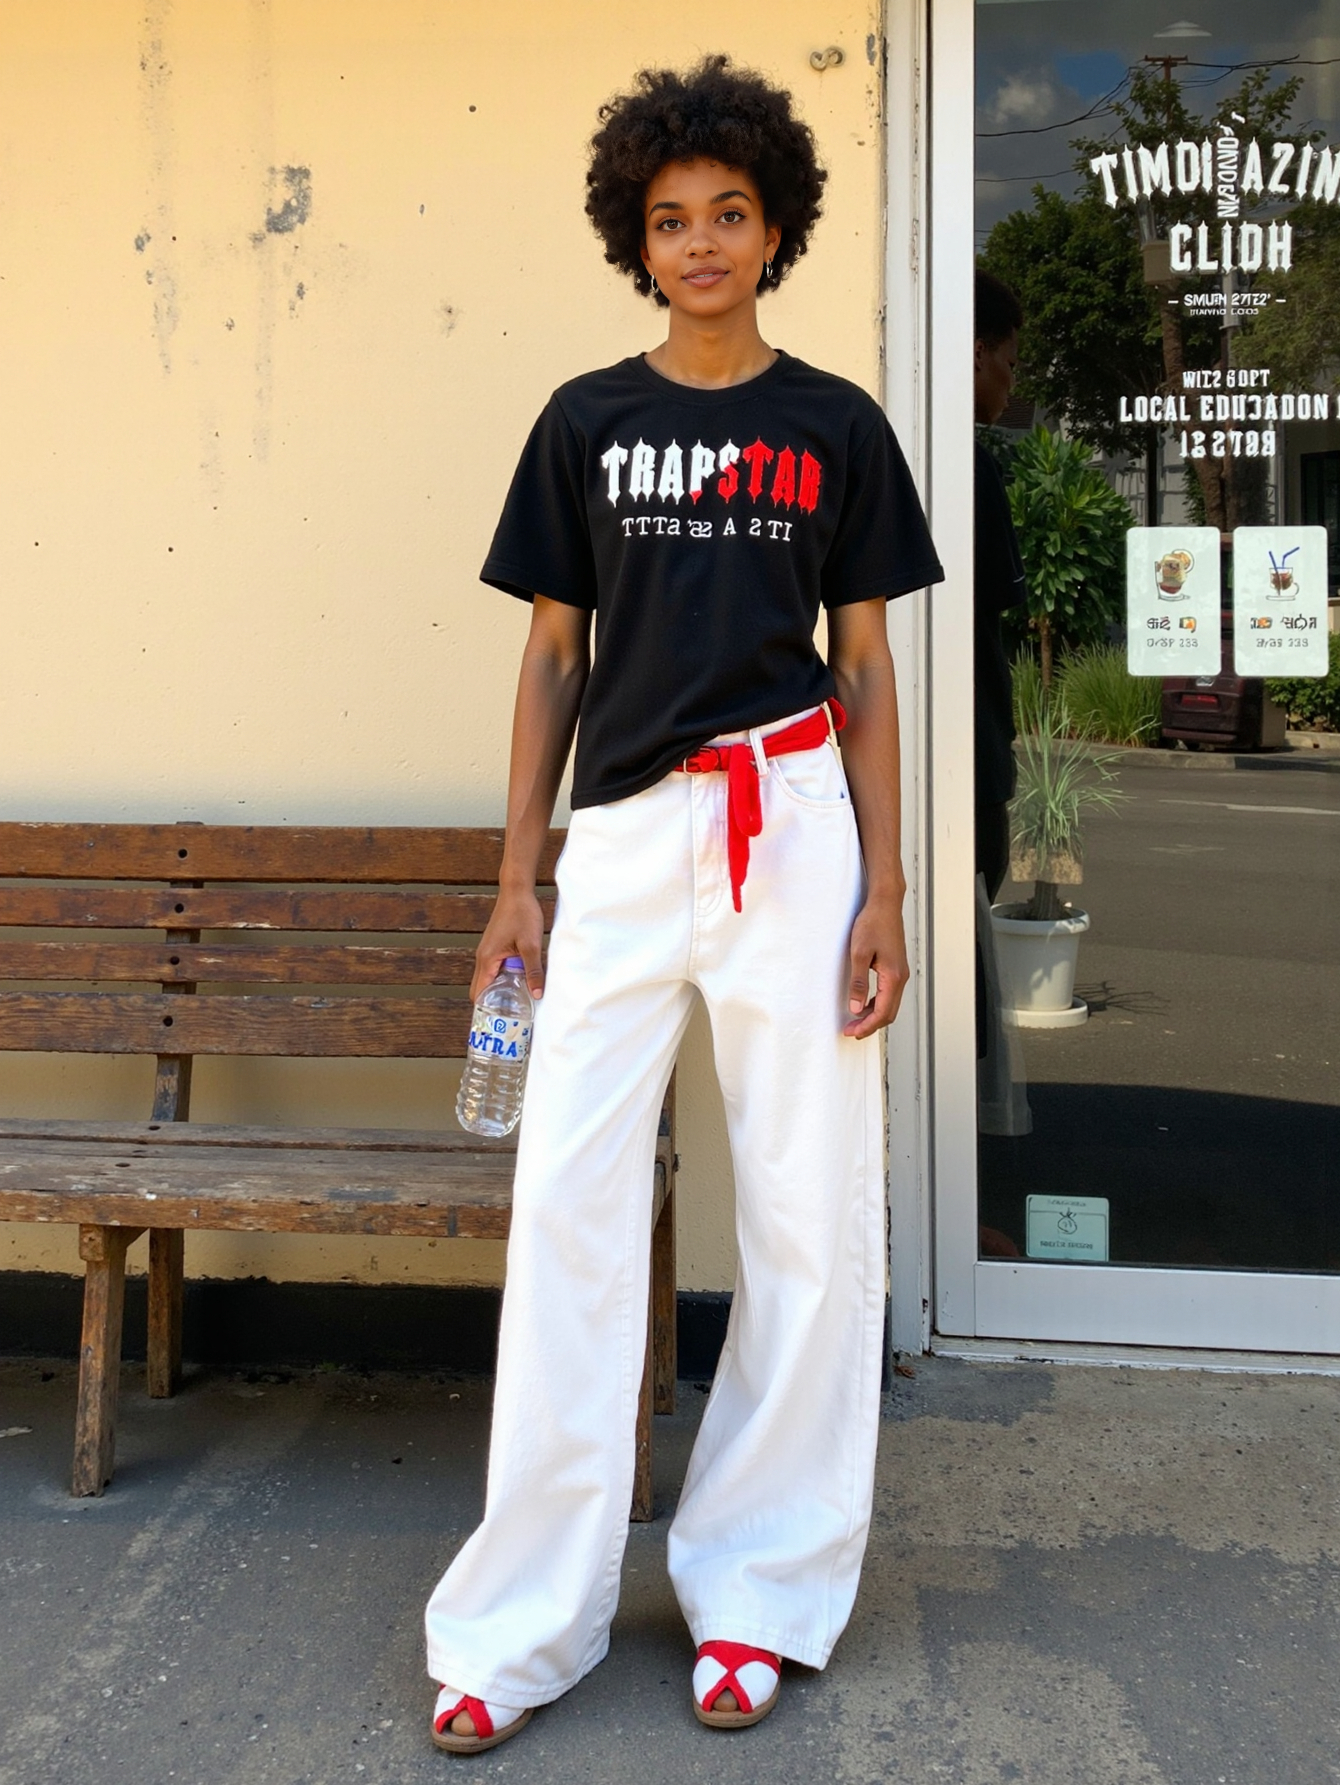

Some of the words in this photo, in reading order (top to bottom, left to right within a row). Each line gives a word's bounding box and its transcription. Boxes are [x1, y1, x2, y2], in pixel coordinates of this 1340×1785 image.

[1240, 136, 1340, 205] AZIN
[1119, 395, 1192, 422] LOCAL
[601, 436, 822, 516] TRAPSTAR
[722, 517, 737, 536] A
